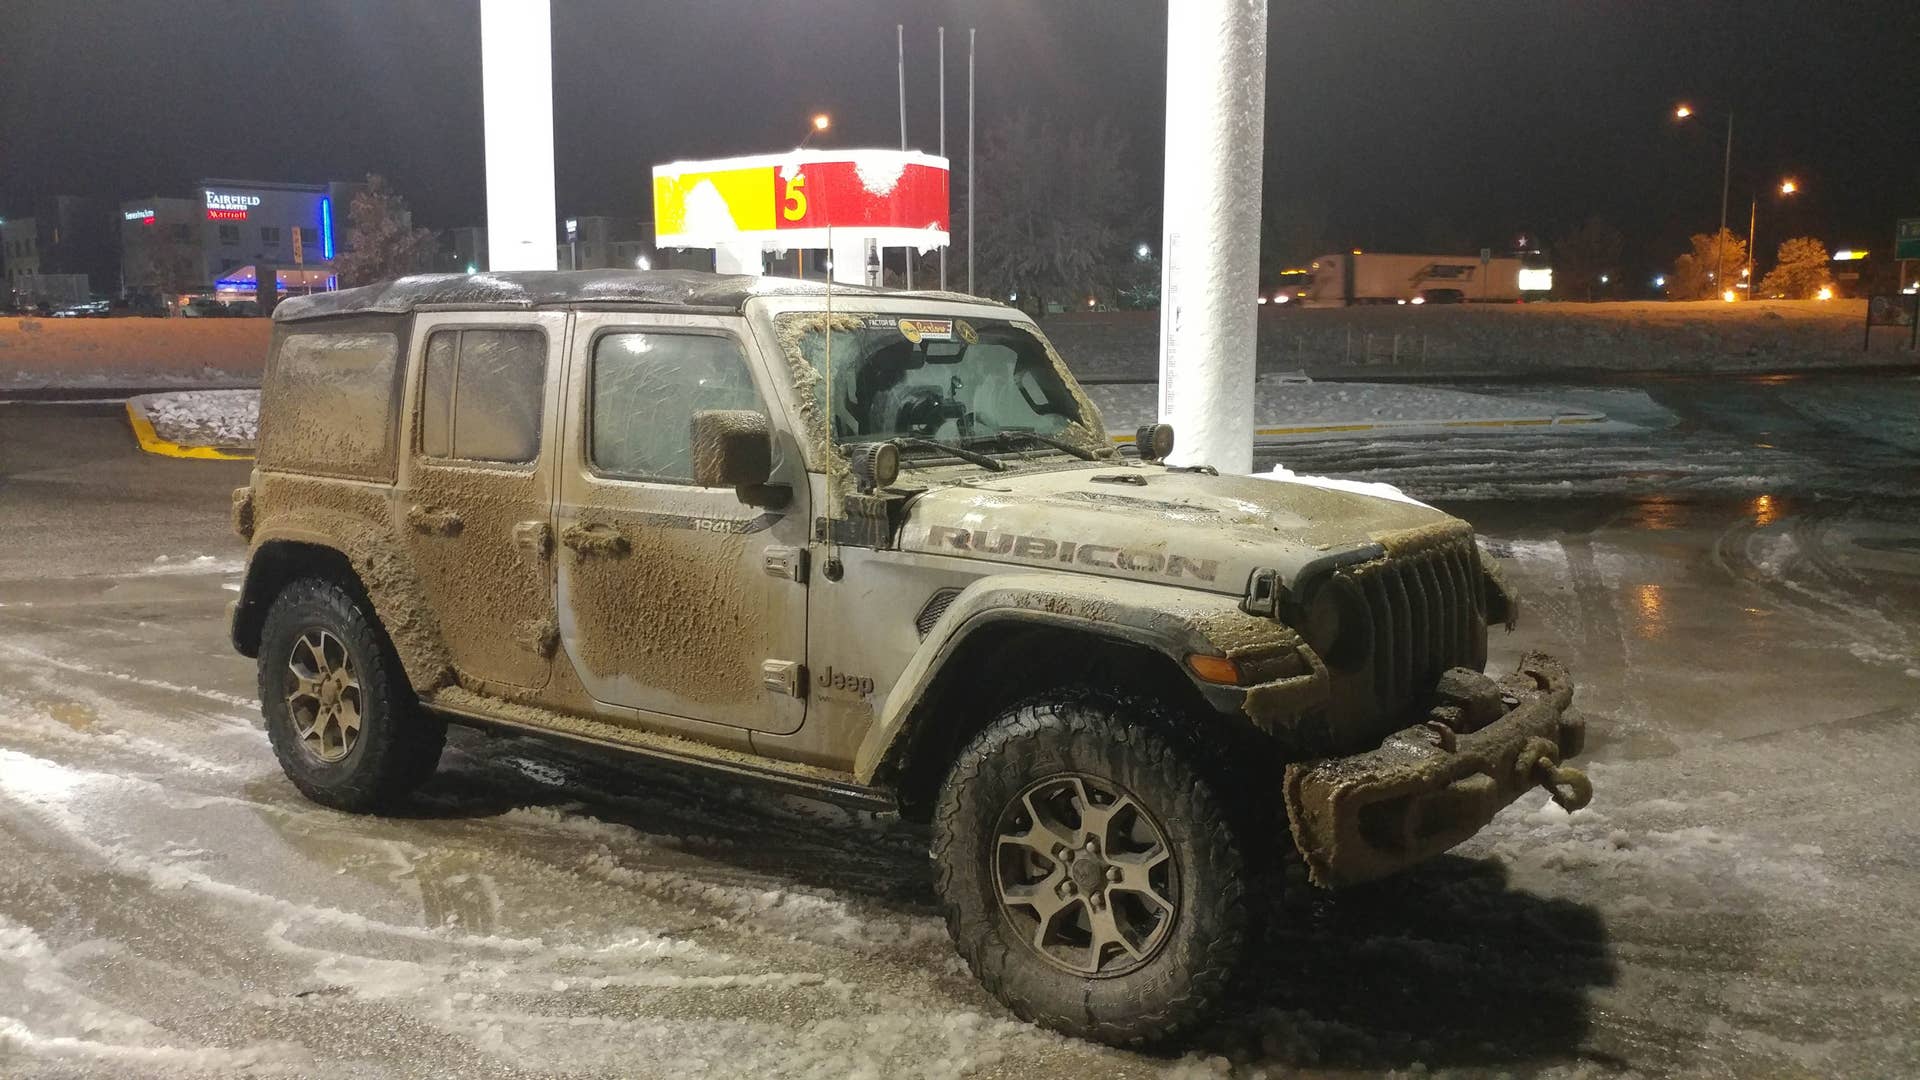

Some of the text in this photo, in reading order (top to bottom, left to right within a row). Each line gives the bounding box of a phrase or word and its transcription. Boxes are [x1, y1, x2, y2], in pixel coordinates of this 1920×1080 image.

[205, 190, 261, 206] FAIRFIELD
[783, 174, 808, 222] 5
[694, 518, 732, 534] 1941
[927, 524, 1217, 582] RUBICON
[818, 665, 874, 699] Jeep
